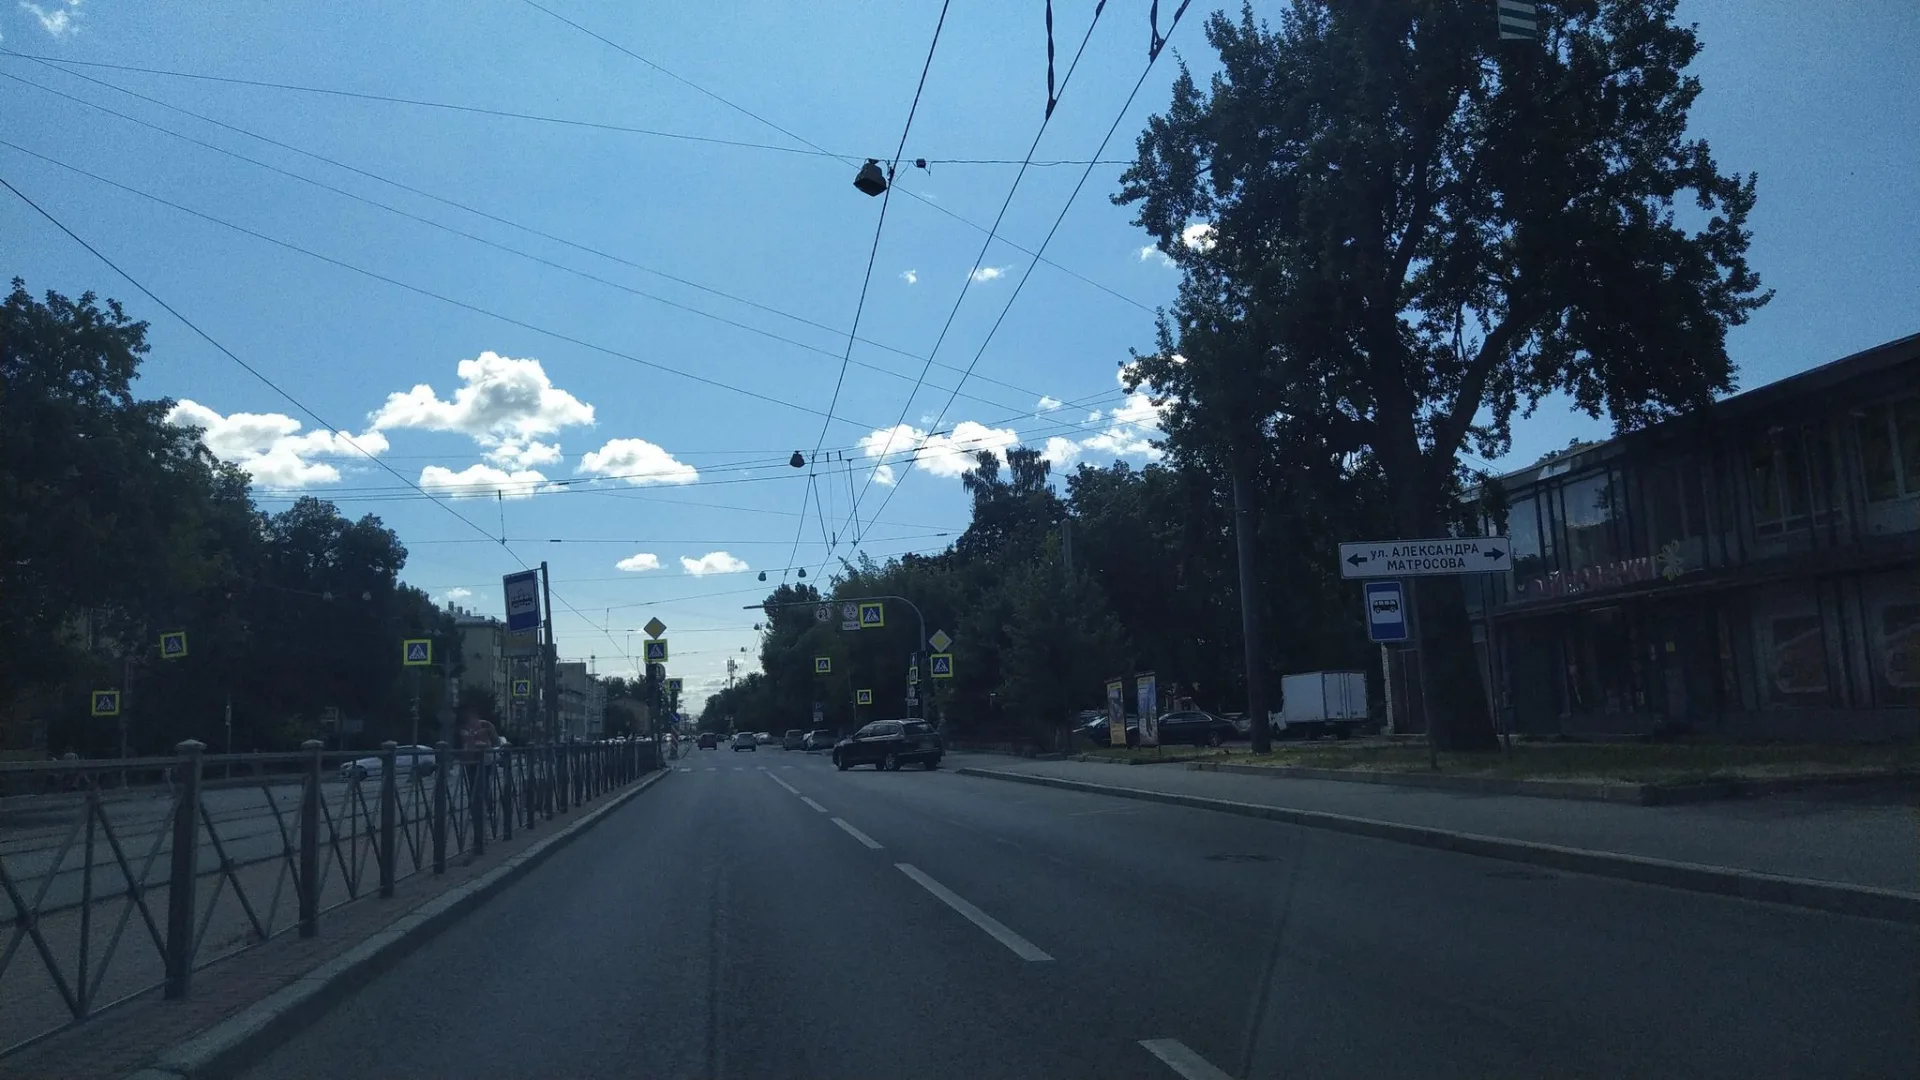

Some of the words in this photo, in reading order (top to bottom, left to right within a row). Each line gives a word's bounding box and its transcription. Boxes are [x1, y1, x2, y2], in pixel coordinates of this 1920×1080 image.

[1370, 549, 1389, 561] ул.
[1392, 543, 1480, 557] АЛЕКСАНДРА
[1387, 557, 1466, 571] МАТРОСОВА
